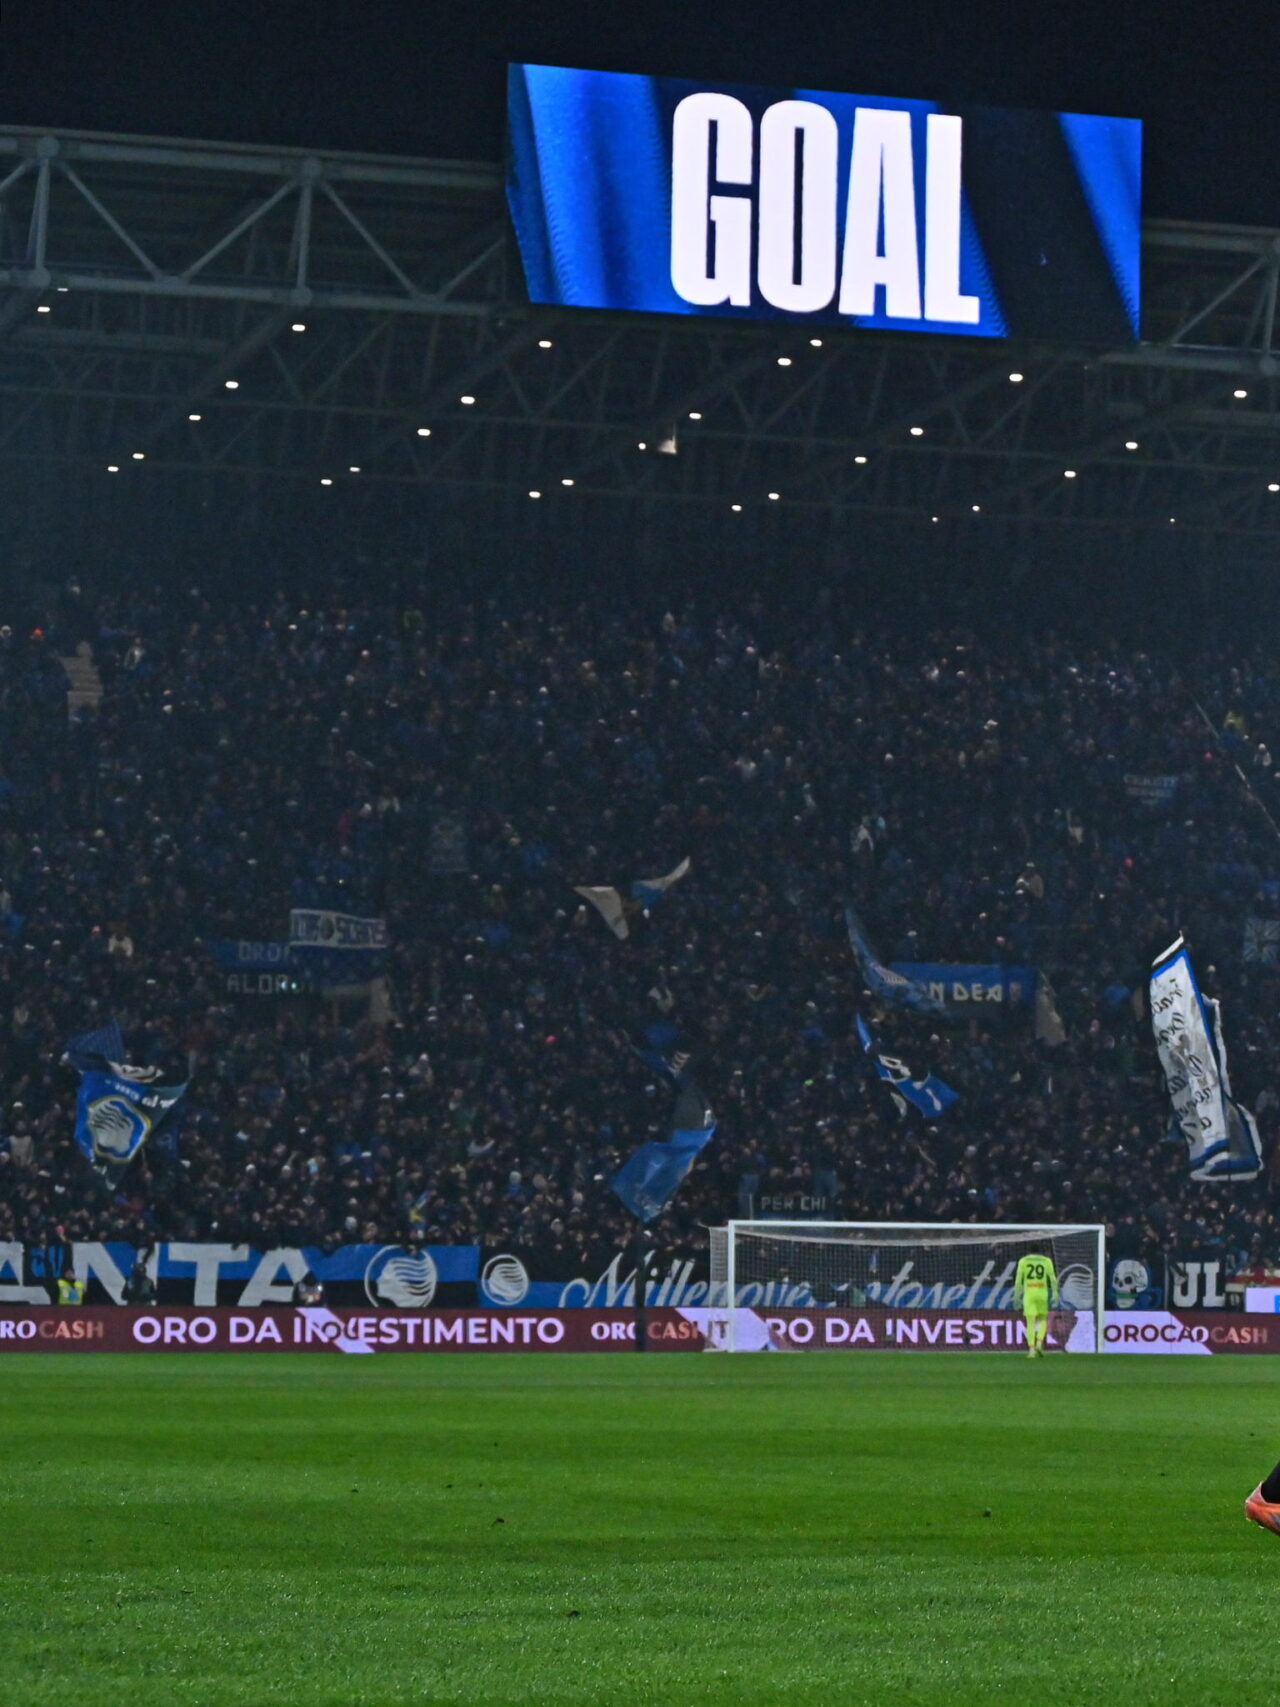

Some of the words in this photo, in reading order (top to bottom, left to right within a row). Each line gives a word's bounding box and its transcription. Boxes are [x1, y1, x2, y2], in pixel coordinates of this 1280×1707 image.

[670, 92, 980, 324] GOAL
[1026, 1263, 1045, 1280] 29
[132, 1316, 217, 1344] ORO
[229, 1316, 282, 1344] DA
[825, 1318, 876, 1343] DA
